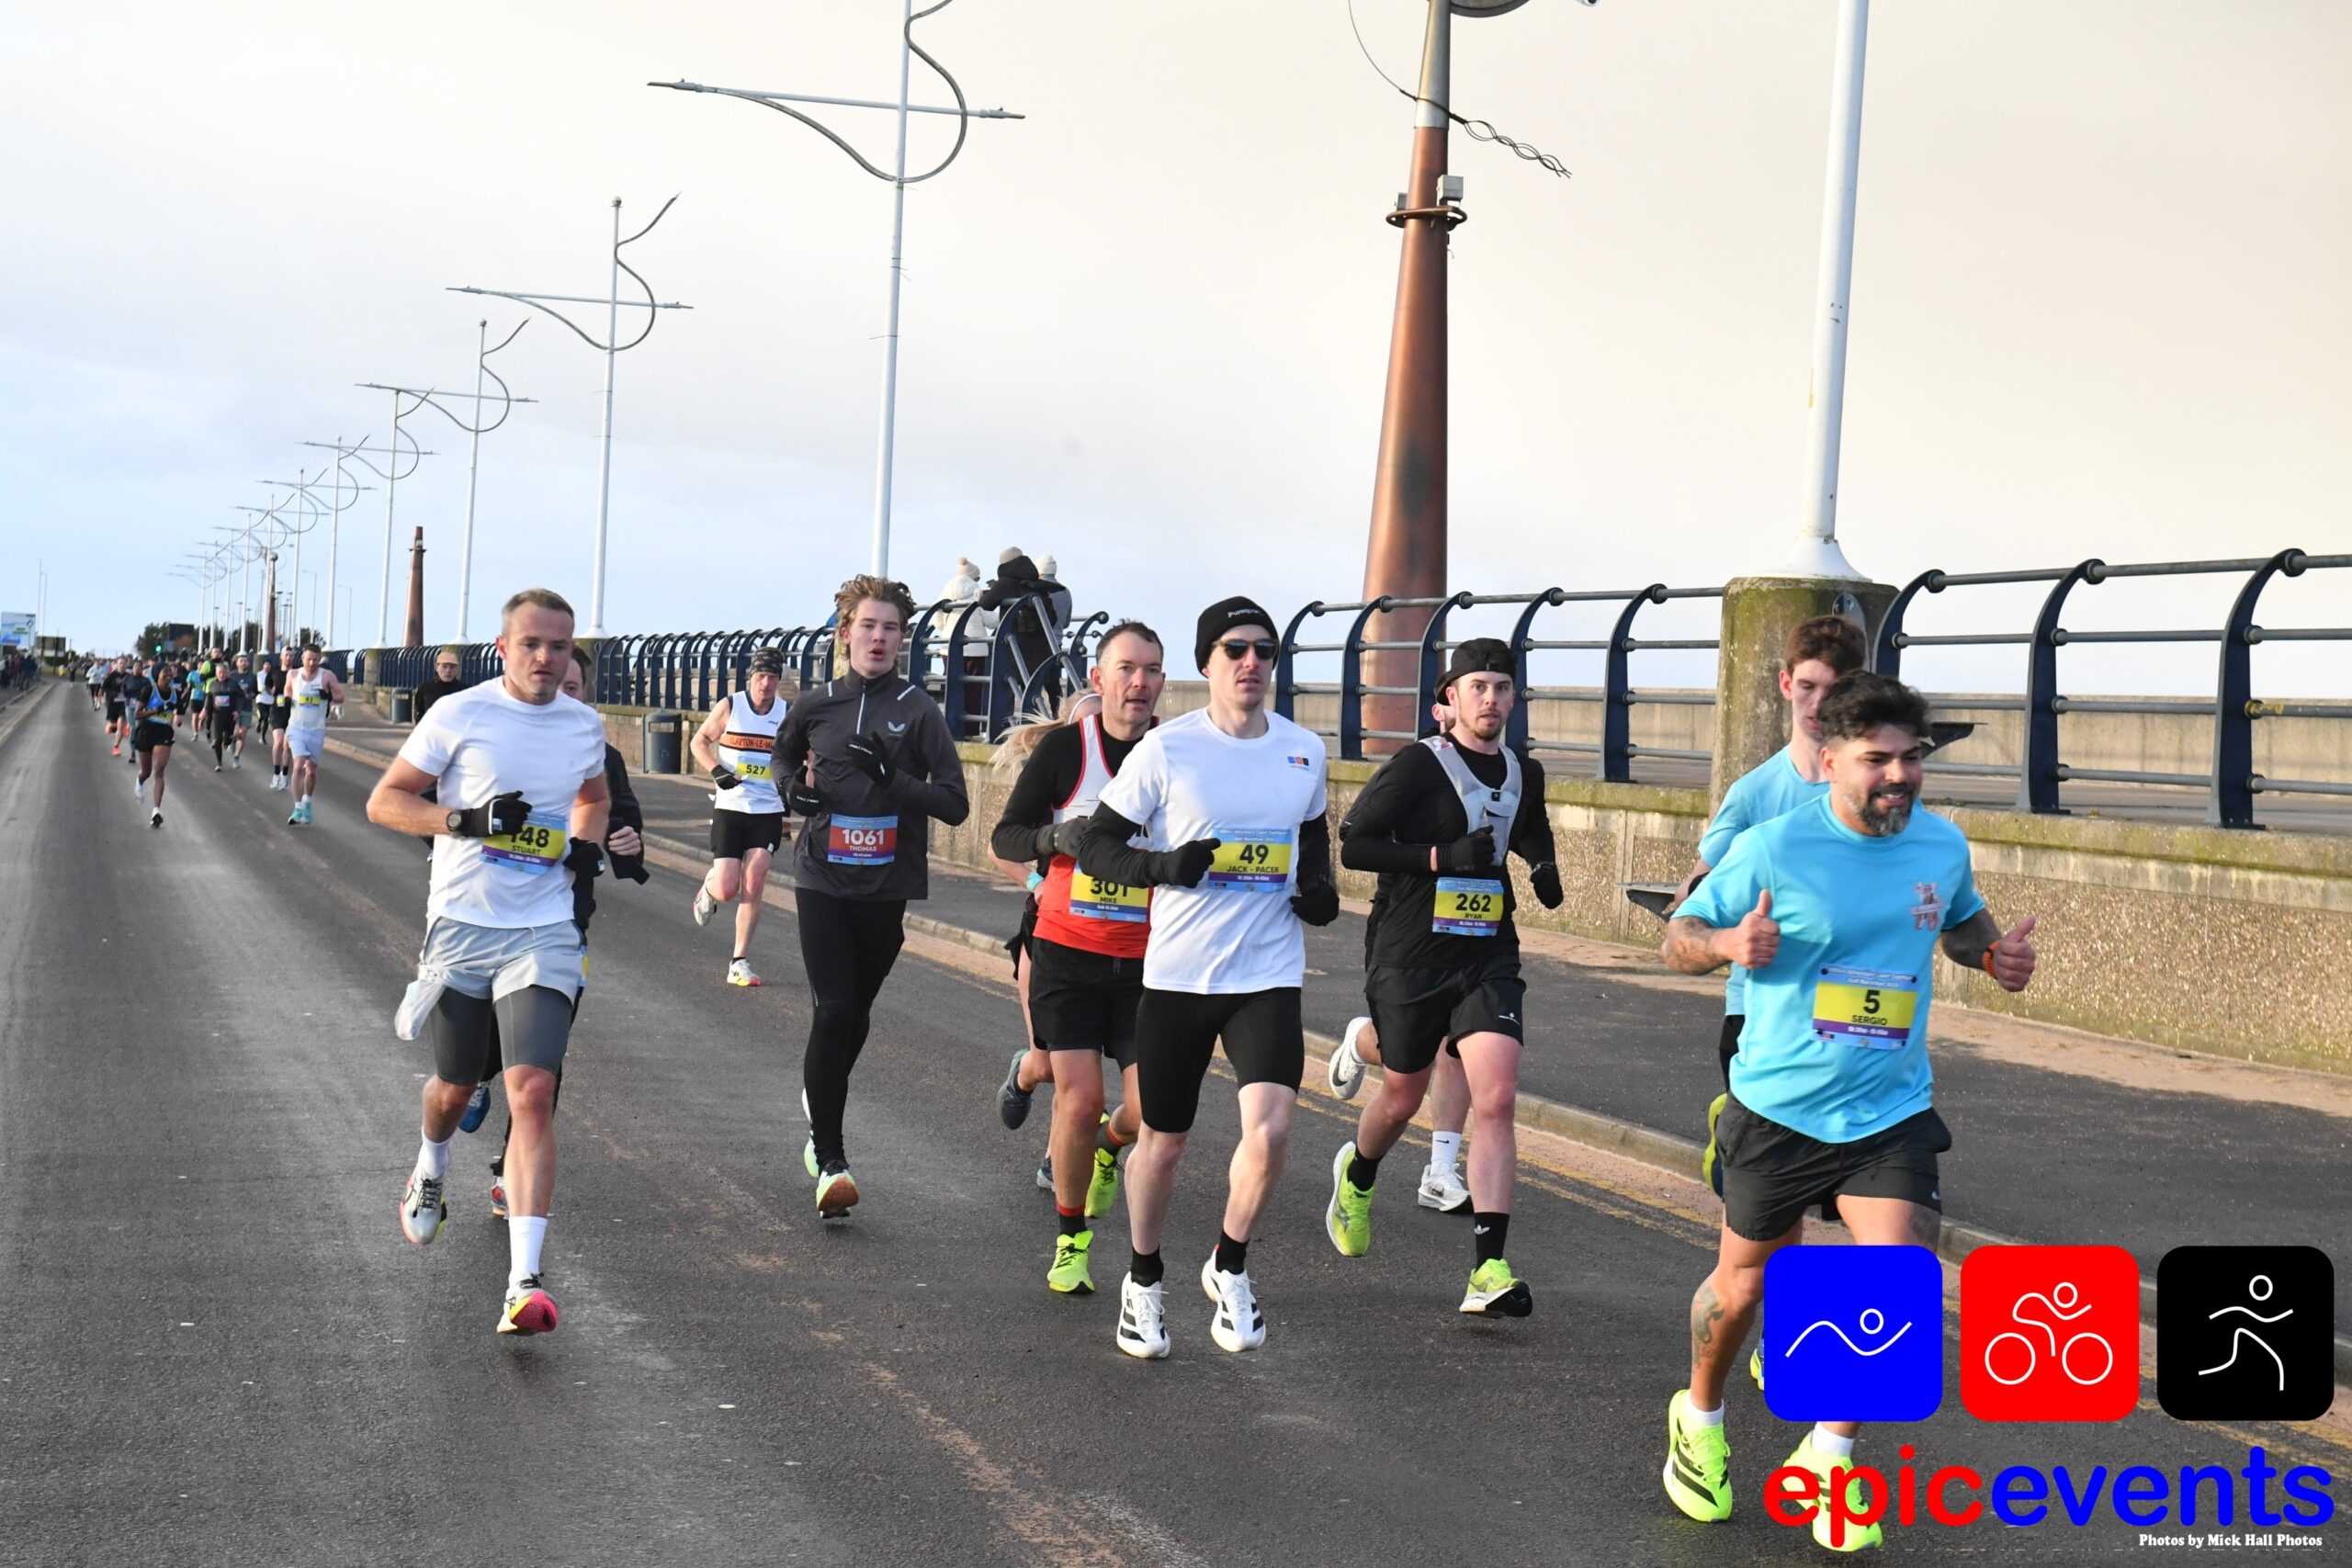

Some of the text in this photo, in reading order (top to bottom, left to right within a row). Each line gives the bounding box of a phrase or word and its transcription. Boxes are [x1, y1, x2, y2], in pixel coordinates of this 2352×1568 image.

[729, 738, 773, 749] CLAYTON-LE-M
[745, 764, 766, 776] 527
[842, 829, 884, 846] 1061
[511, 845, 541, 855] STUART
[1239, 844, 1269, 864] 49
[1455, 893, 1491, 912] 262
[1862, 989, 1881, 1015] 5
[1851, 1014, 1888, 1026] SERGIO
